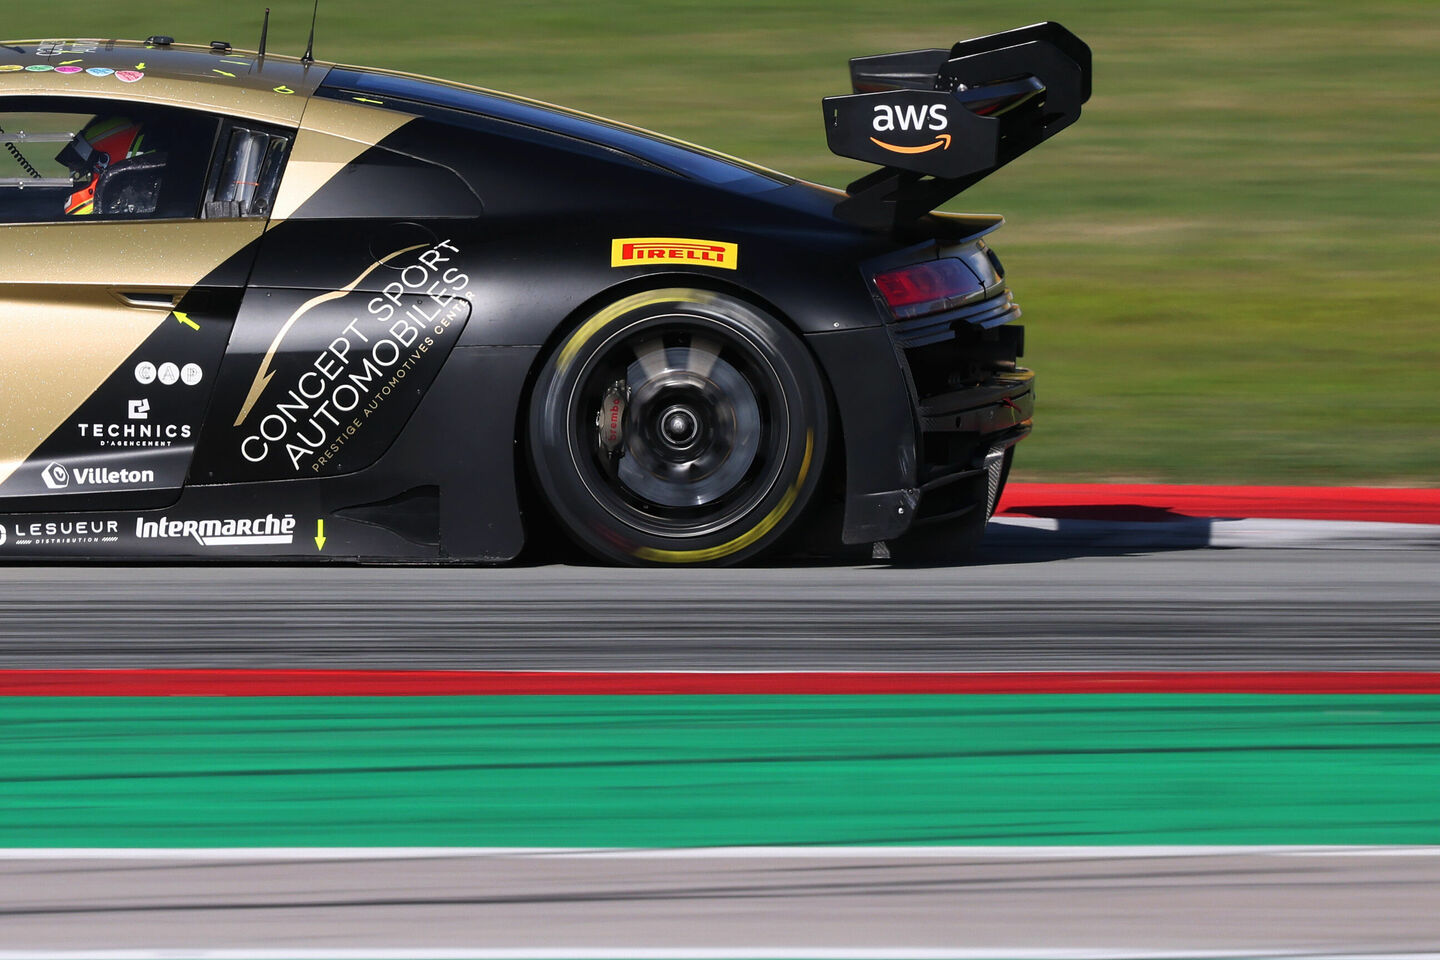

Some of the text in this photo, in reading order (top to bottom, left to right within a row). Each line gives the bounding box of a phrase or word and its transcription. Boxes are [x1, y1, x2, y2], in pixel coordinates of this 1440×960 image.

[872, 103, 948, 132] aws
[622, 243, 726, 263] PIRELLI
[241, 239, 460, 462] CONCEPT SPORT
[136, 364, 201, 384] CAP
[285, 267, 469, 470] AUTOMOBILES
[312, 290, 476, 472] PRESTIGE AUTOMOTIVES CENTER
[608, 398, 621, 441] brembo
[78, 423, 192, 438] TECHNICS
[73, 468, 155, 485] Villeton
[15, 520, 119, 537] LESUEUR
[35, 537, 100, 545] DISTRIBUTION
